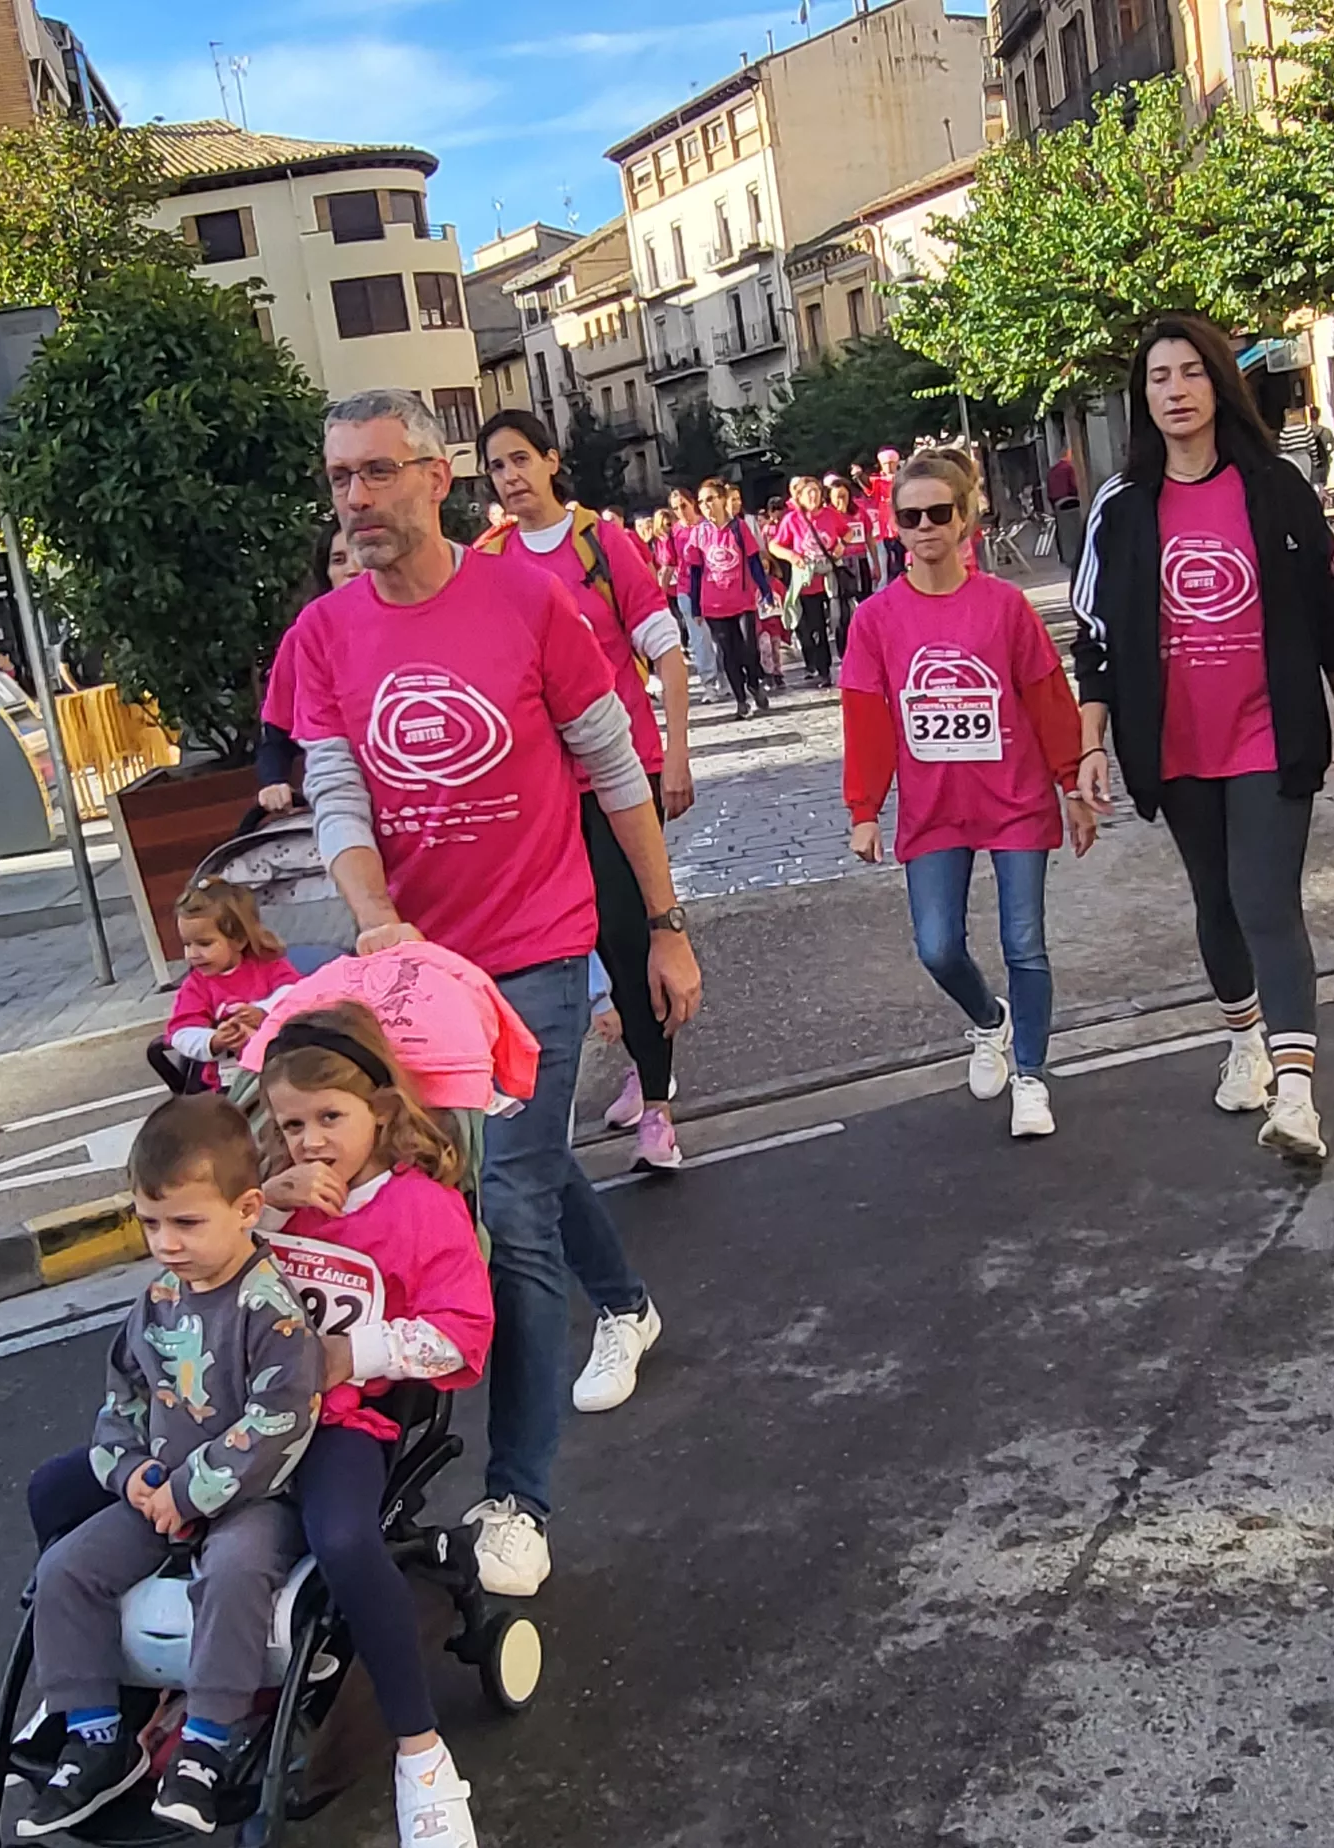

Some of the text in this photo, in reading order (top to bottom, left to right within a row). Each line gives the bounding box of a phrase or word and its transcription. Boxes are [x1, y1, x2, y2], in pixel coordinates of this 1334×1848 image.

[912, 713, 991, 740] 3289
[296, 1264, 310, 1277] EL
[313, 1267, 368, 1290] CÁNCER
